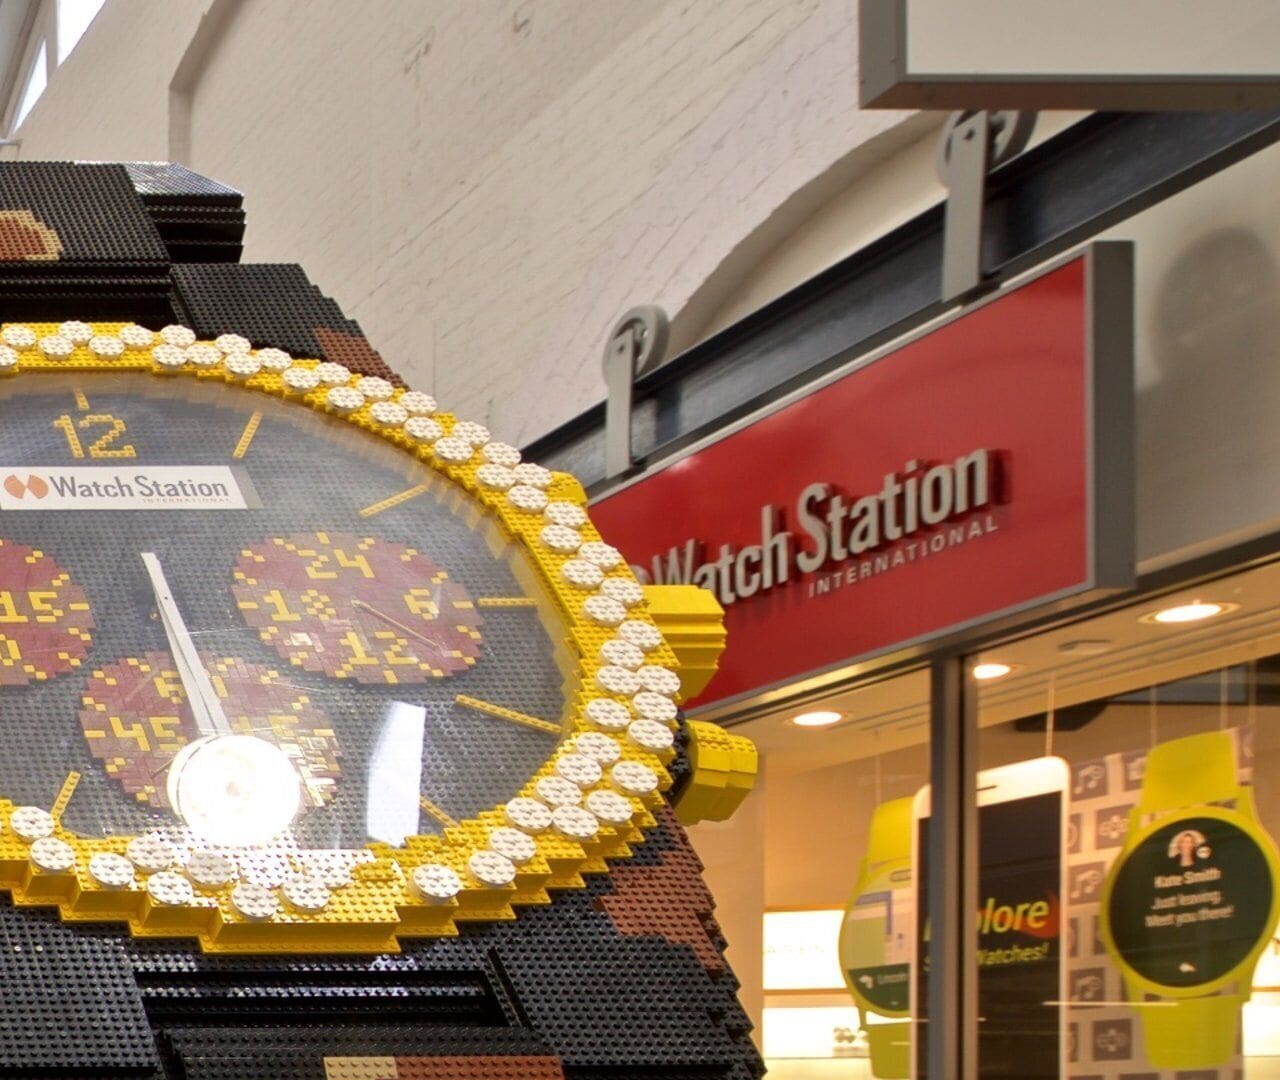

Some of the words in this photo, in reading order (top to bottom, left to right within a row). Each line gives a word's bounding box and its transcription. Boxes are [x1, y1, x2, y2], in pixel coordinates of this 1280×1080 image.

[54, 414, 137, 459] 12
[49, 476, 135, 498] Watch
[134, 474, 230, 498] Station
[796, 448, 989, 575] Station
[297, 550, 376, 579] 24
[808, 514, 999, 600] INTERNATIONAL
[403, 588, 440, 621] 6
[339, 631, 420, 665] 12
[109, 716, 188, 752] 45
